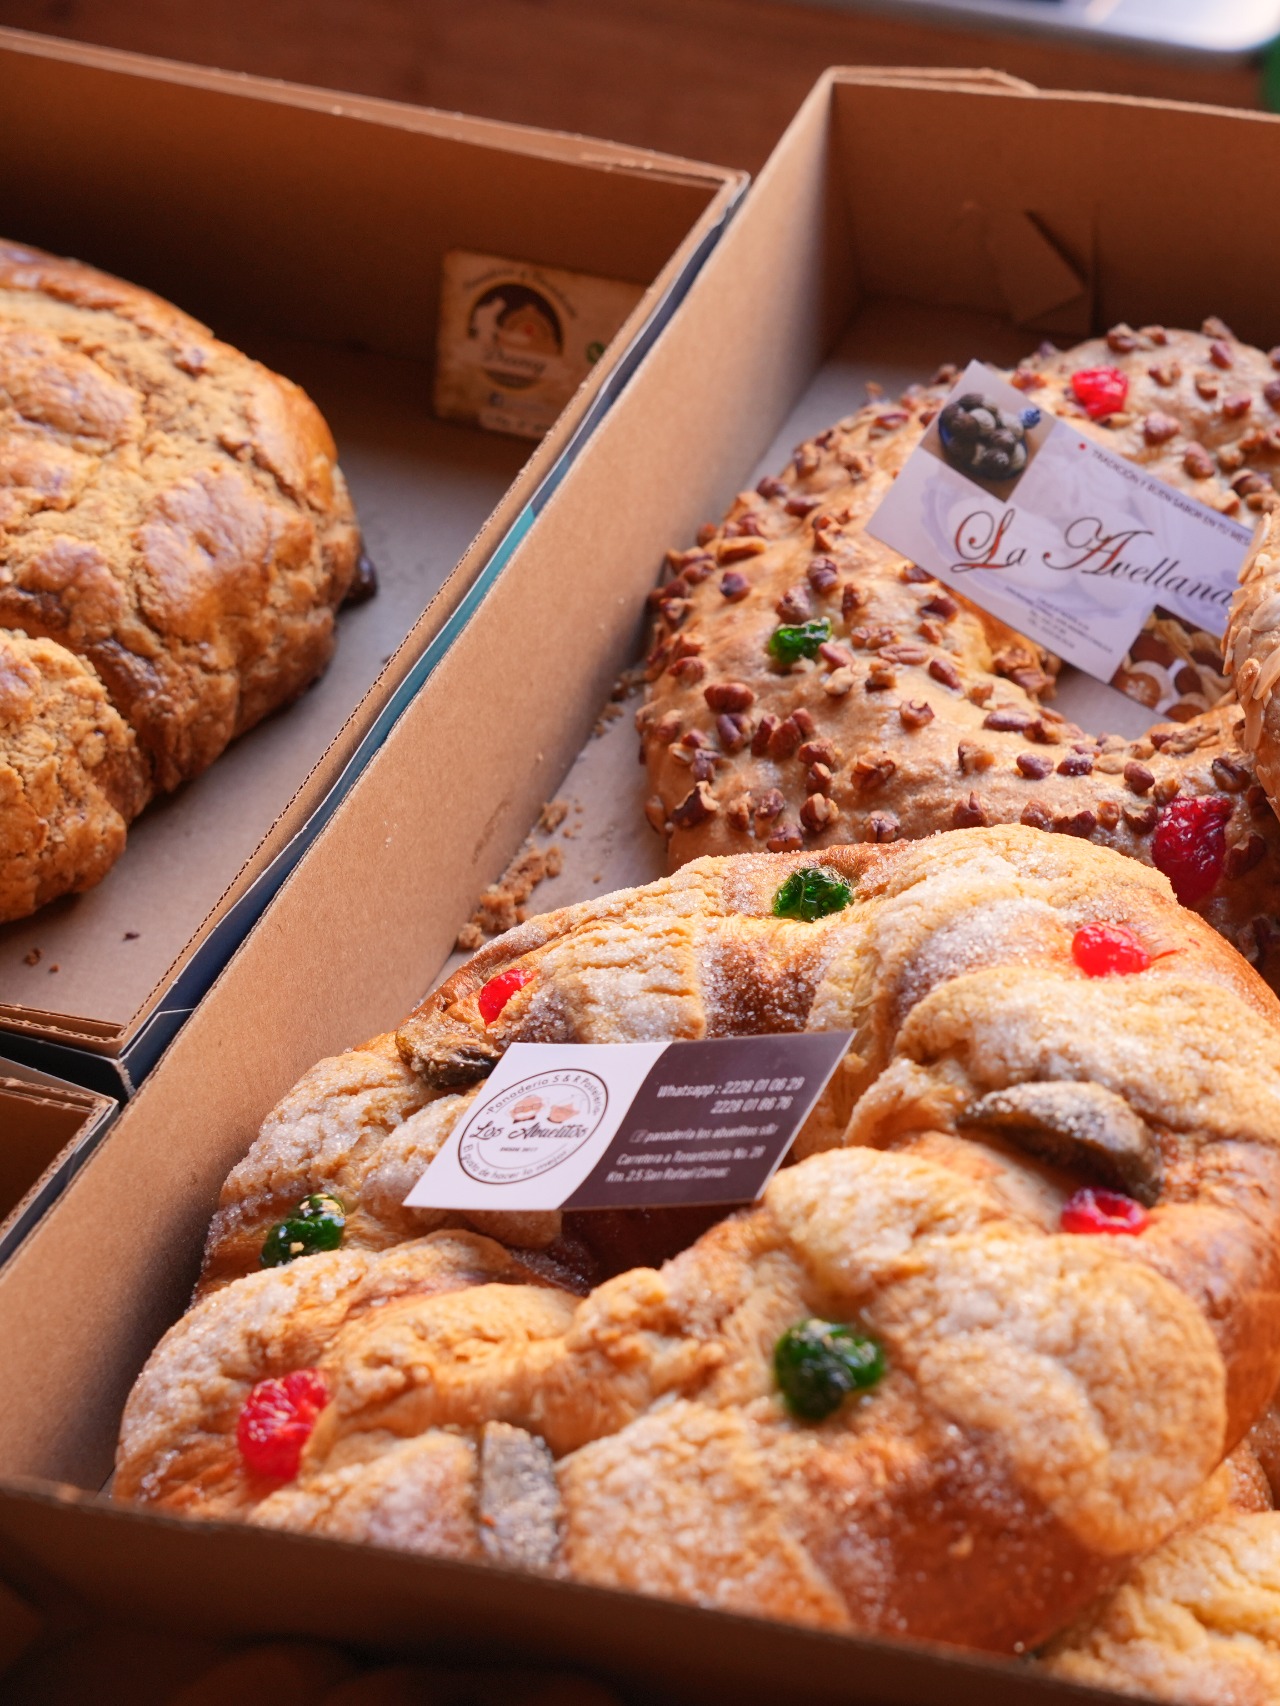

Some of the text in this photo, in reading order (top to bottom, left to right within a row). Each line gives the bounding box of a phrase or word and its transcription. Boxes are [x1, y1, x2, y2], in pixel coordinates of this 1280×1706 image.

[950, 508, 1233, 606] La Avellana
[469, 1120, 504, 1140] Los
